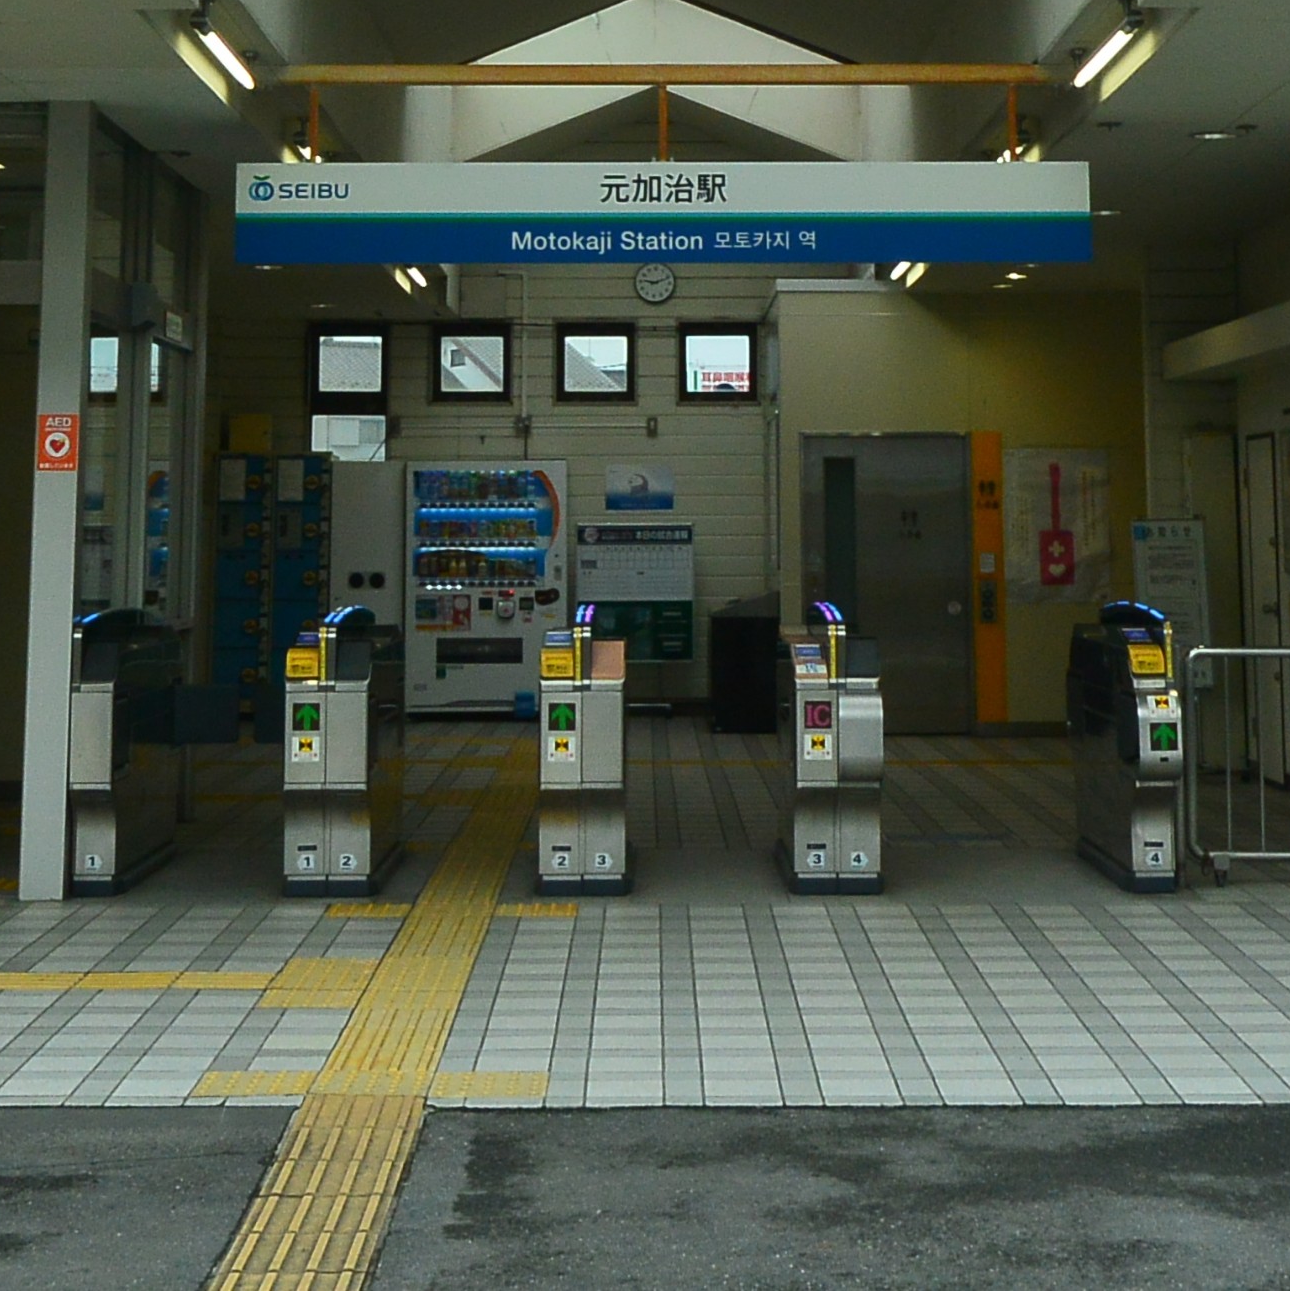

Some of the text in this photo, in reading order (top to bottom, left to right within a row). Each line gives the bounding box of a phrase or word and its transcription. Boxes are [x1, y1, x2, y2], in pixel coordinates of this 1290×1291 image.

[278, 182, 350, 201] SEIBU
[598, 173, 728, 204] 元加治駅
[511, 230, 817, 255] Motokaji Station 모토카지 역
[45, 417, 72, 427] AED
[806, 704, 830, 727] IC
[88, 857, 95, 867] 1
[304, 857, 310, 867] 1
[342, 856, 351, 867] 2
[557, 856, 566, 867] 2
[597, 856, 606, 866] 3
[812, 854, 821, 864] 3
[853, 854, 862, 864] 4
[1150, 853, 1159, 864] 4
